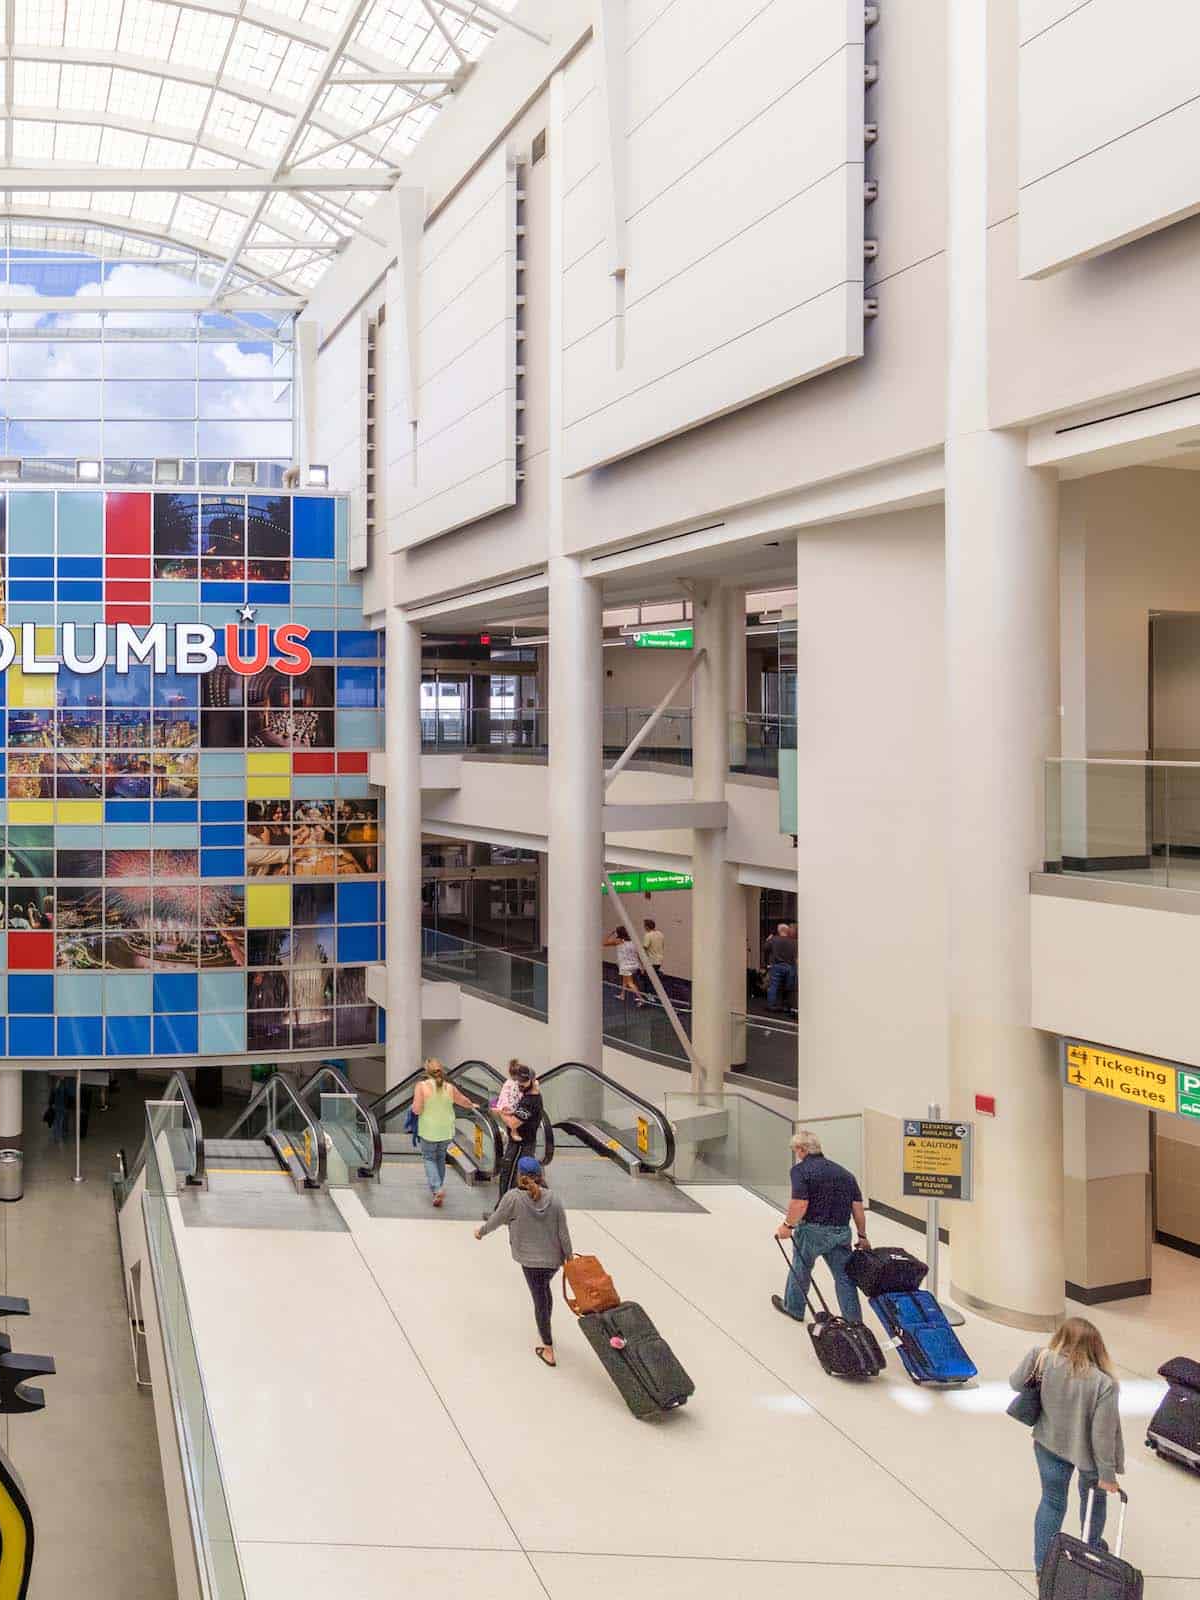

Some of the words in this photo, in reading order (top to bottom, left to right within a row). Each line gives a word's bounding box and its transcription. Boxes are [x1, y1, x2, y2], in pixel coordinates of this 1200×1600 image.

[1093, 1055, 1167, 1085] Ticketing
[1094, 1076, 1114, 1089] All
[1119, 1083, 1166, 1104] Gates
[1184, 1076, 1200, 1094] P
[922, 1123, 953, 1131] ELEVATOR
[920, 1140, 959, 1150] CAUTION
